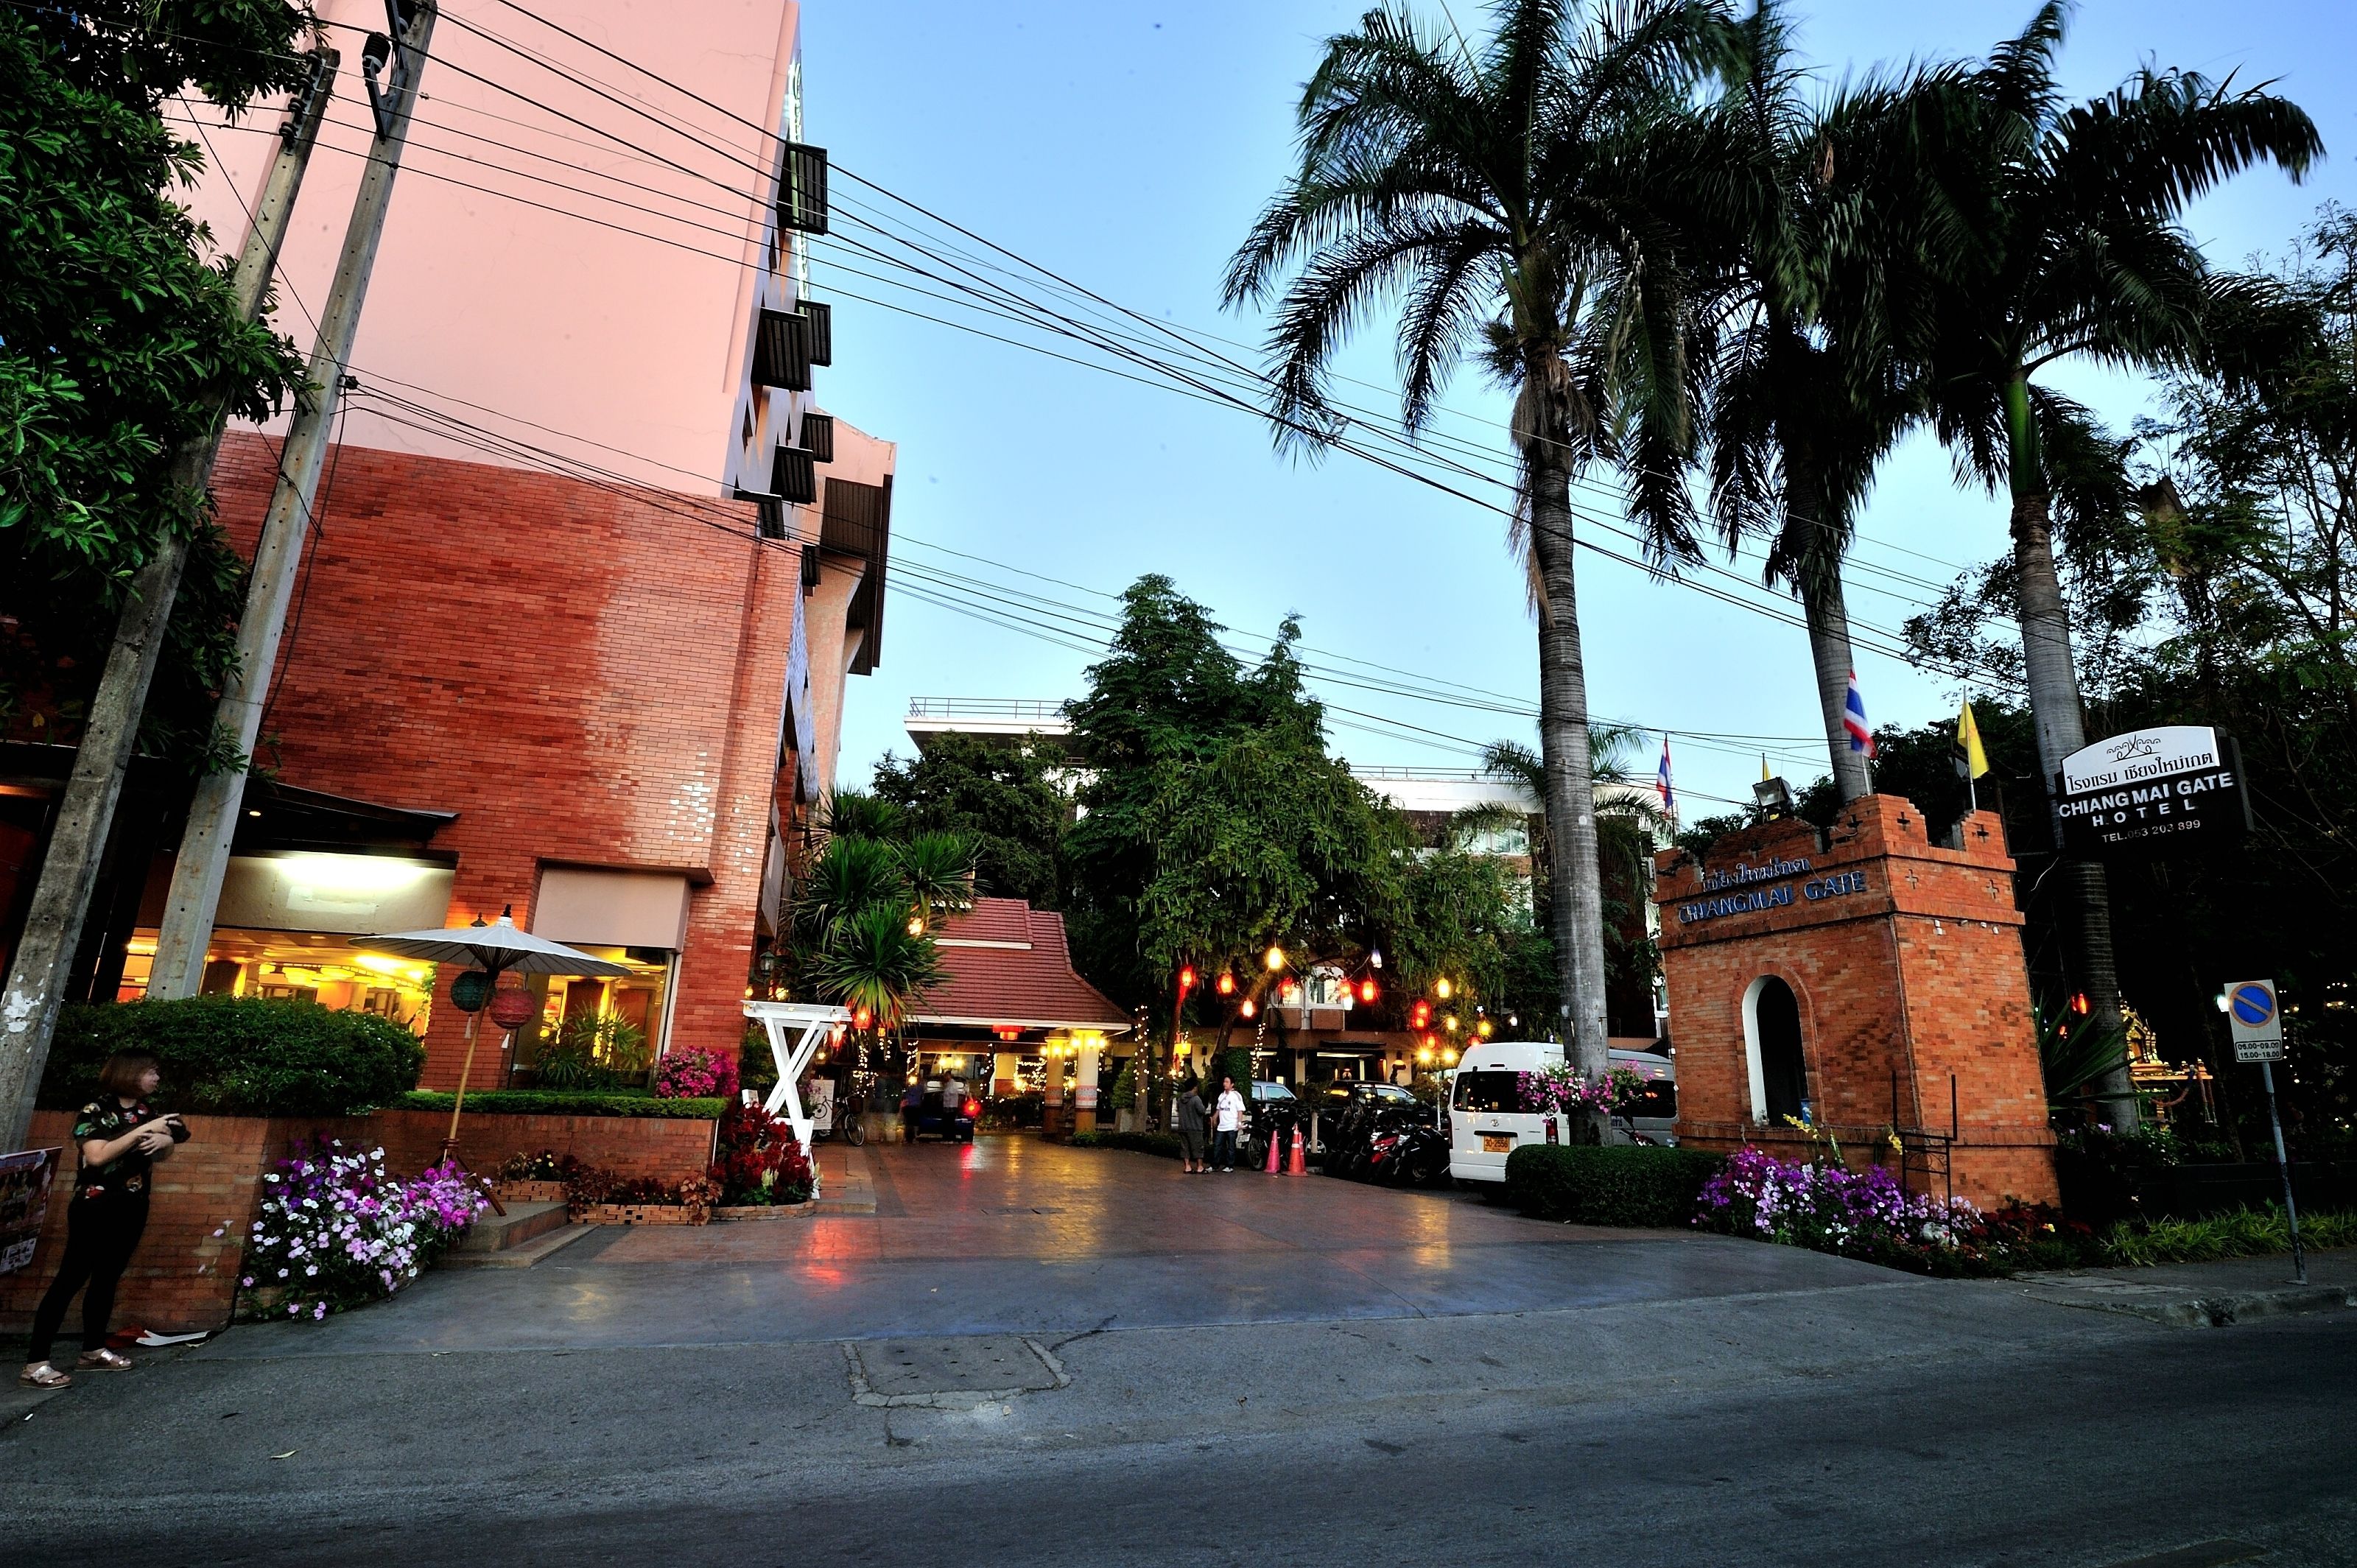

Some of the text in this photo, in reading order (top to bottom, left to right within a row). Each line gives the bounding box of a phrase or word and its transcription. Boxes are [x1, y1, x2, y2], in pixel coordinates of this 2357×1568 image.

[2067, 753, 2213, 791] โรงแรม เชียงใหม่เกต
[2059, 772, 2233, 817] CHIANG MAI GATE
[2093, 798, 2196, 827] HOTEL
[2151, 823, 2174, 834] 203
[2178, 820, 2201, 831] 899
[1804, 871, 1866, 900] GATE
